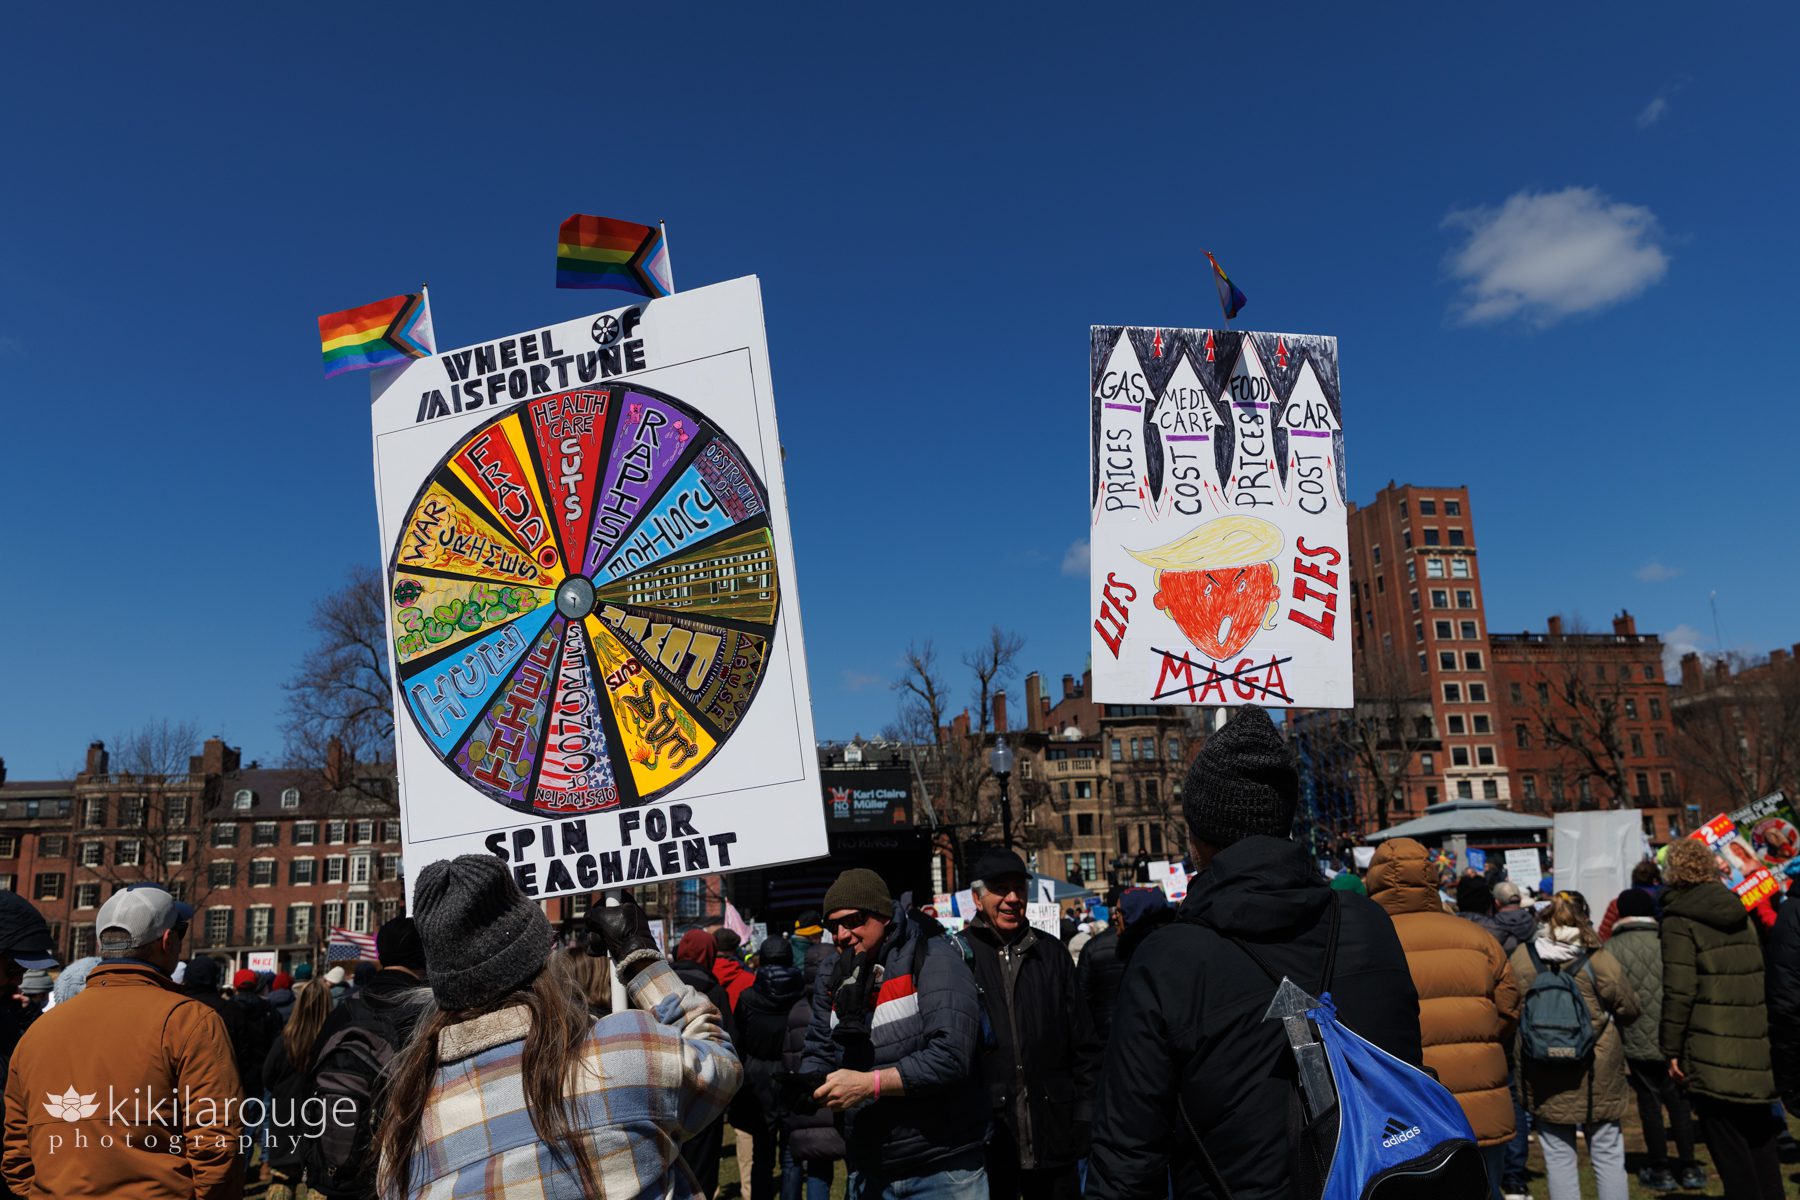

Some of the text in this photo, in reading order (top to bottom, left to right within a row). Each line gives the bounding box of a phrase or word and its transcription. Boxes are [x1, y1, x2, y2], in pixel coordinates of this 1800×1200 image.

[441, 307, 641, 382] WHEEL OF
[415, 338, 646, 423] MISFORTUNE
[532, 393, 607, 427] HEALTH
[1100, 371, 1145, 404] GAS
[1159, 387, 1208, 410] MEDI
[1230, 375, 1270, 402] FOOD
[550, 415, 594, 438] CARE
[1160, 411, 1214, 433] CARE
[1286, 400, 1331, 430] CAR
[560, 437, 583, 522] CUTS
[591, 408, 668, 566] RAPIST
[706, 443, 763, 516] OBSTRUCTION
[716, 480, 733, 499] OF
[1105, 428, 1140, 511] PRICES
[1169, 445, 1202, 516] COST
[1234, 412, 1273, 507] PRICES
[1294, 450, 1327, 515] COST
[465, 434, 545, 551] FRAUD
[403, 500, 446, 561] WAR
[438, 525, 538, 580] CRIMES
[608, 478, 729, 578] JUSTICE
[1093, 571, 1137, 660] LIES
[1287, 535, 1341, 641] LIES
[600, 604, 722, 690] POWER
[605, 657, 643, 692] CUTS
[710, 633, 753, 718] ABUSE
[1153, 650, 1292, 704] MAGA
[411, 623, 528, 738] ICE
[558, 625, 596, 773] CONGRESS
[472, 637, 560, 792] THIEF
[620, 679, 699, 769] EPA
[535, 787, 617, 808] OBSTRUCTION
[567, 774, 588, 790] OF
[834, 801, 849, 810] NO
[875, 788, 907, 799] Claire
[1763, 792, 1784, 805] YOU
[485, 803, 700, 863] SPIN FOR
[512, 832, 737, 897] EACHMENT
[1382, 1125, 1421, 1148] adidas
